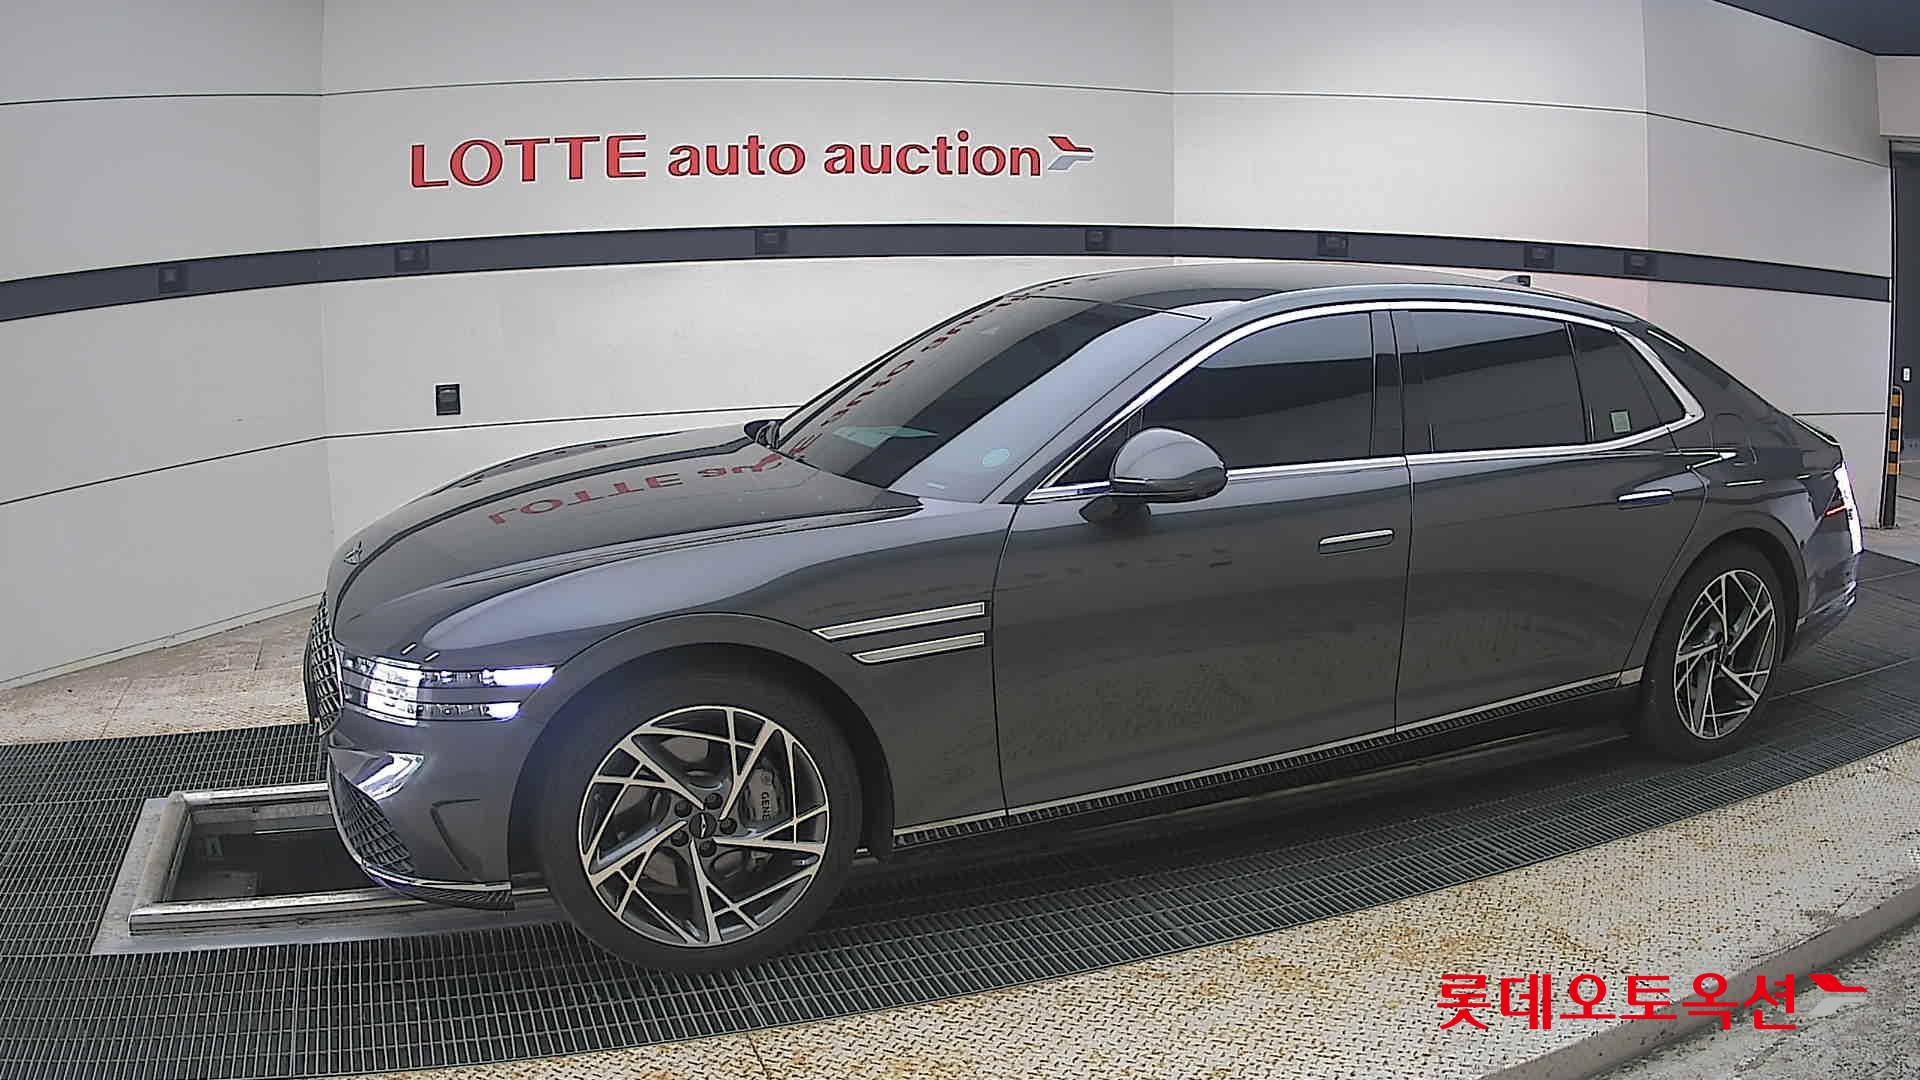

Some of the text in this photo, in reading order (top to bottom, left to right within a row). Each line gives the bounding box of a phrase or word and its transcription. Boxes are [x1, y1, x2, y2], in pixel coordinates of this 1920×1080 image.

[411, 130, 1041, 188] LOTTE auto auction
